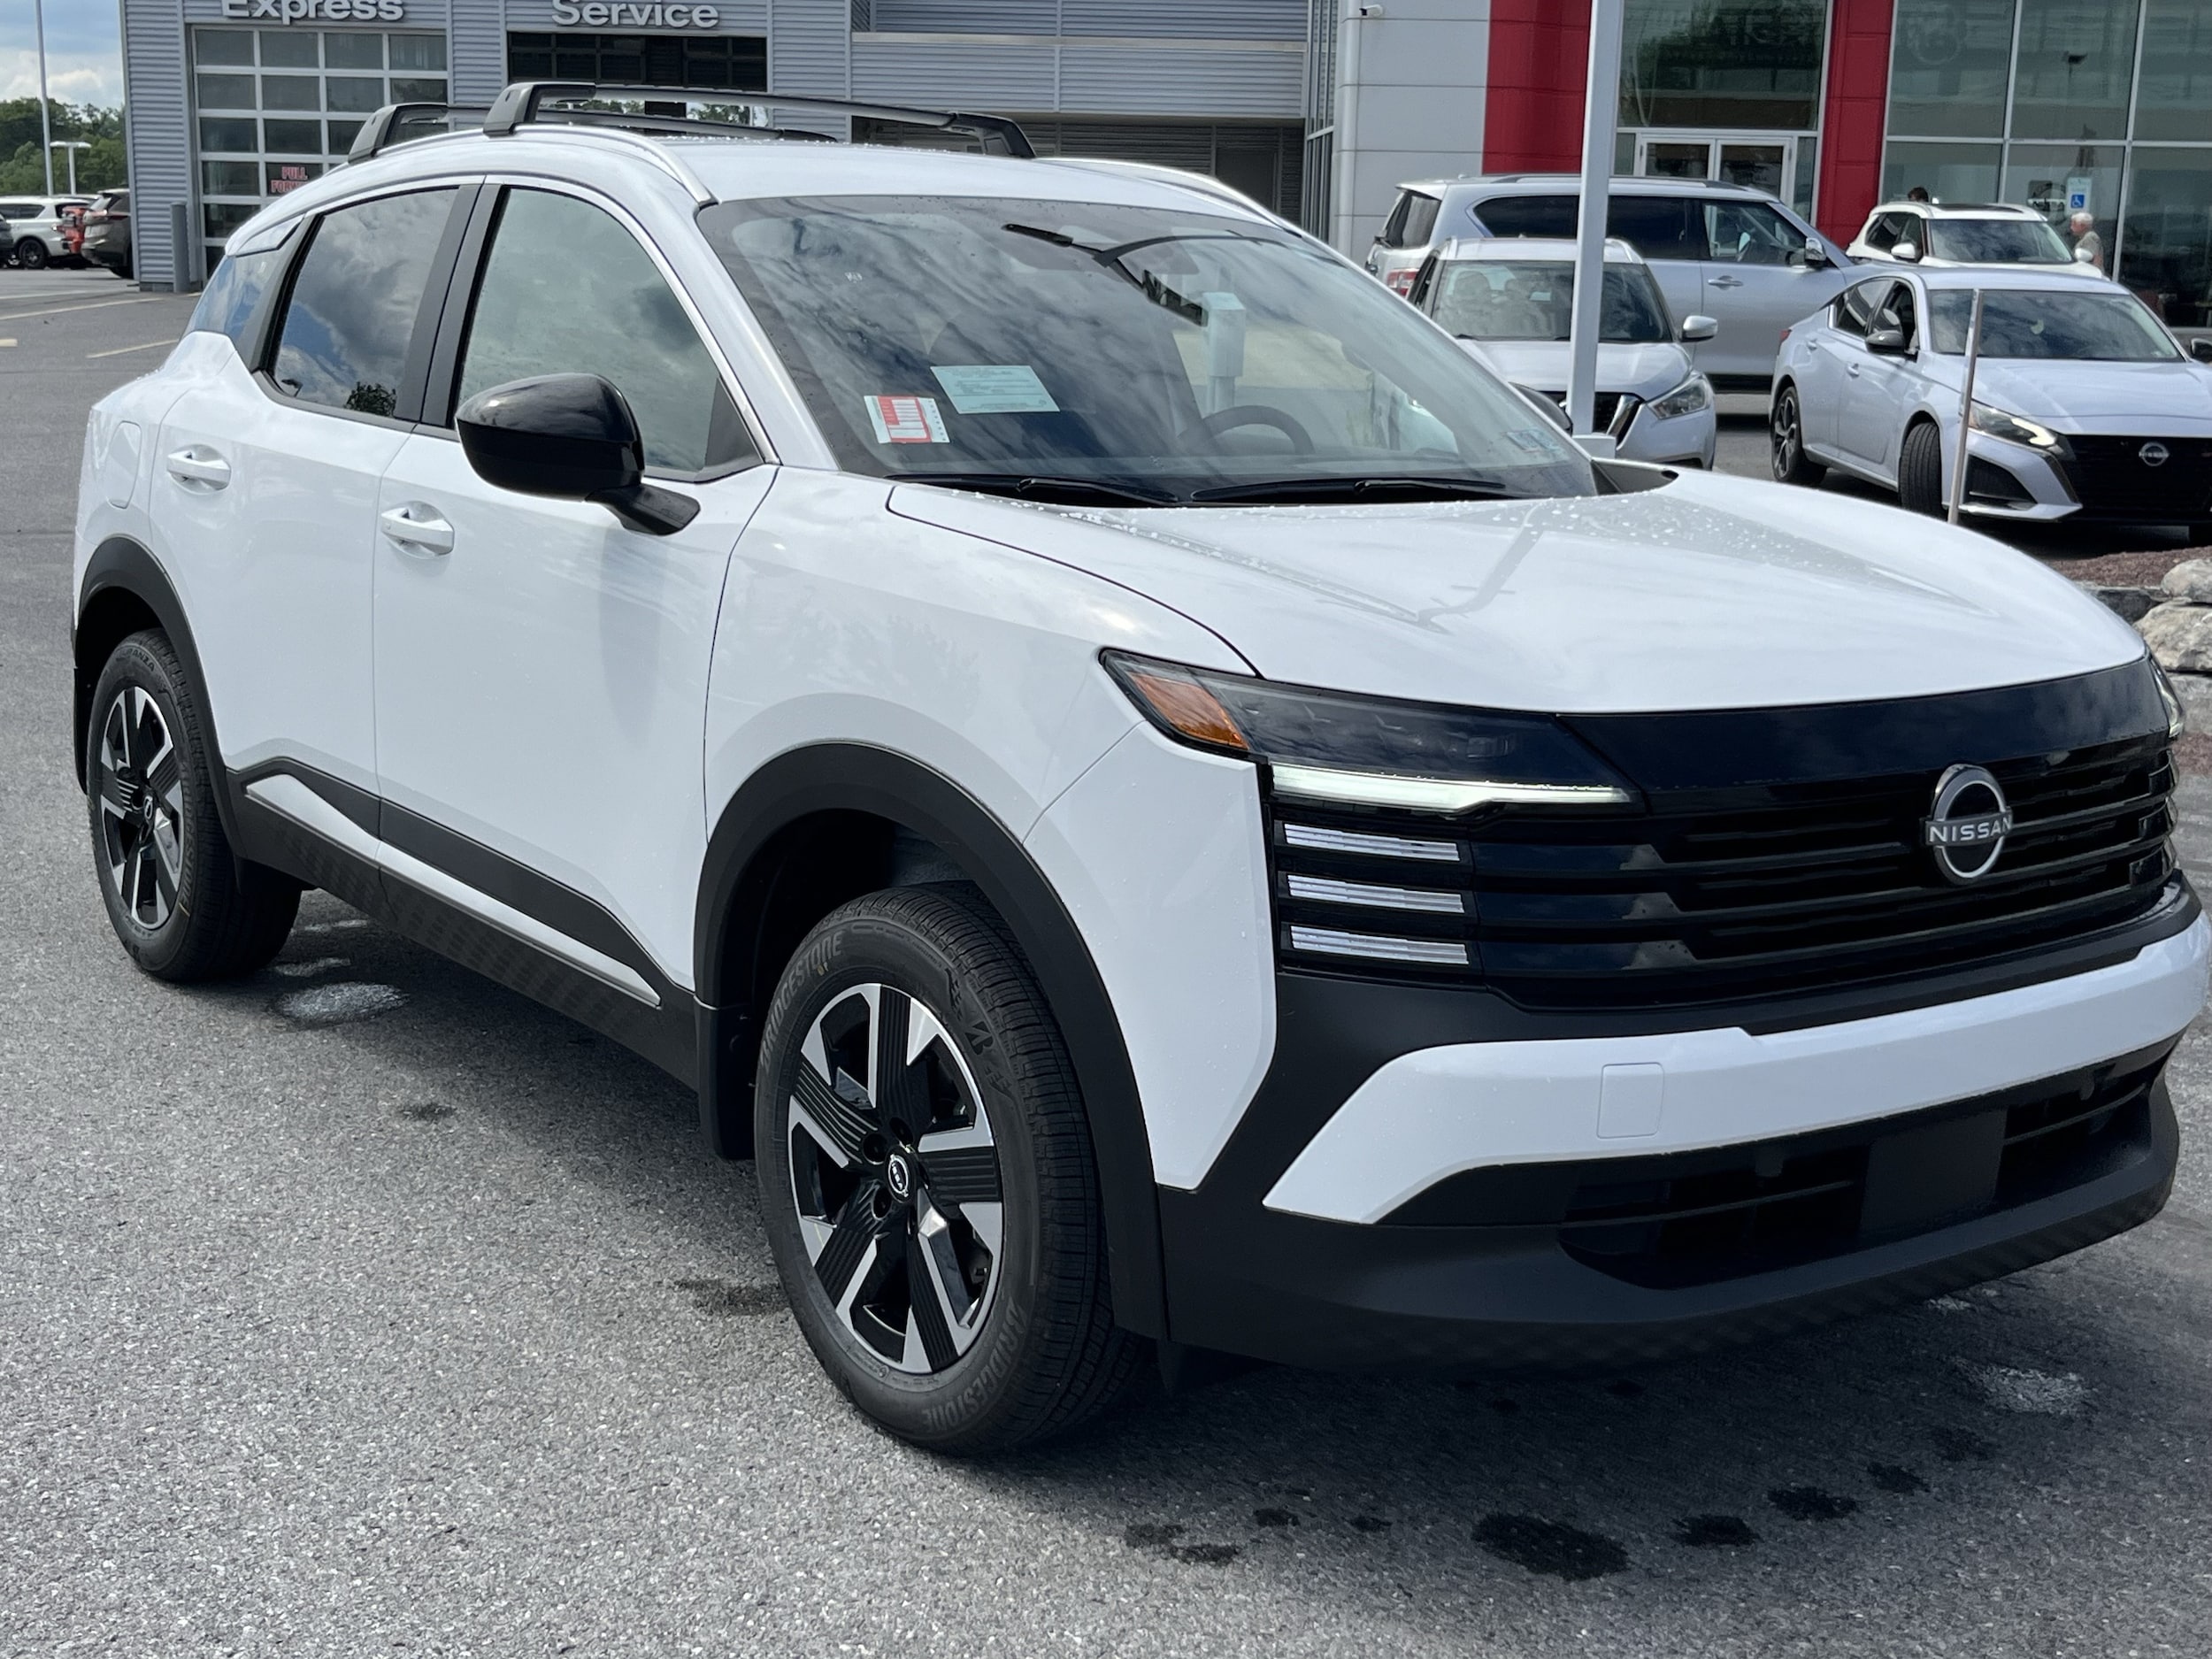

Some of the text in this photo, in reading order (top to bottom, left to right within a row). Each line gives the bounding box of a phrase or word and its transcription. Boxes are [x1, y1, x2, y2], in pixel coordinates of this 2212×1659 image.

[221, 0, 404, 26] Express
[551, 0, 719, 28] Service
[281, 166, 308, 180] PULL
[271, 180, 307, 193] FORW
[1929, 815, 2012, 842] NISSAN
